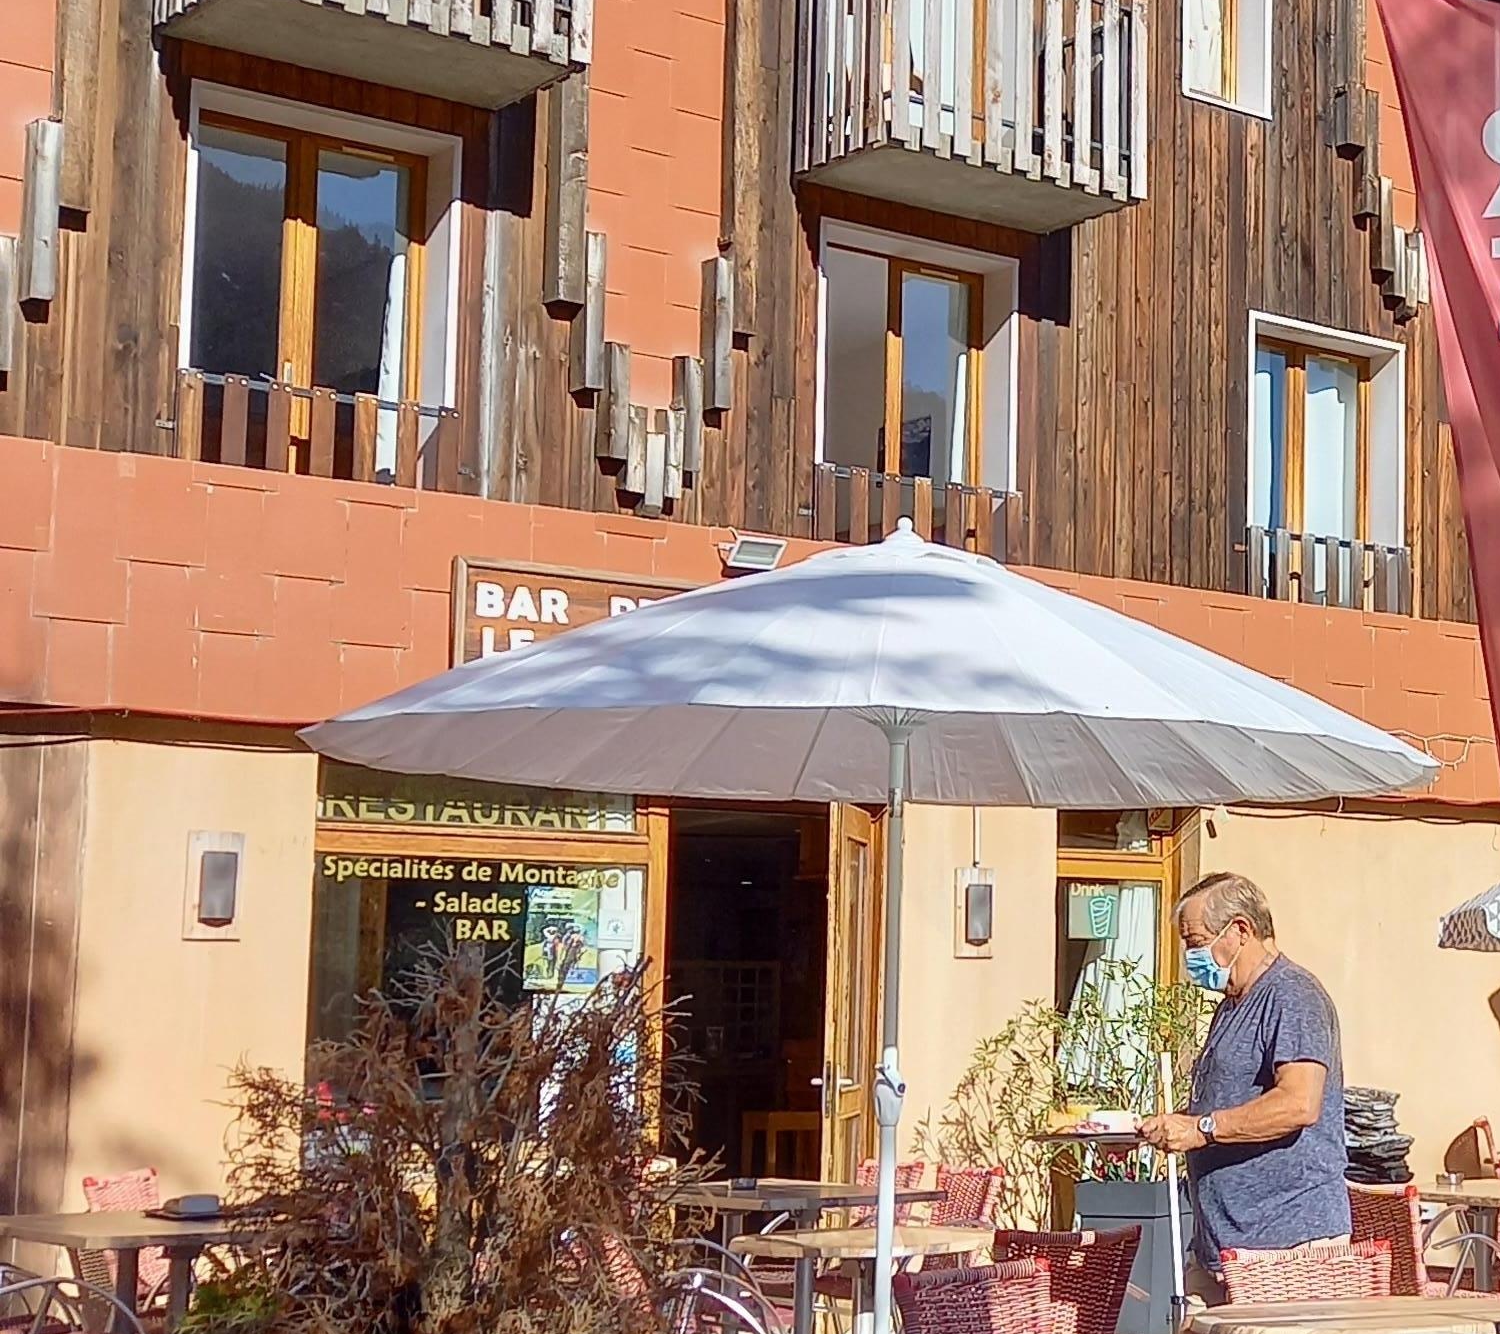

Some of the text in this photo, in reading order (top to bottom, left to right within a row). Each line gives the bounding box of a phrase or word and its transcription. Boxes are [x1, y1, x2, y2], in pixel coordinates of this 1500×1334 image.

[475, 581, 569, 625] BAR
[322, 854, 620, 891] Spécialités de Montagne
[1070, 882, 1105, 897] Drink
[432, 891, 522, 915] Salades
[454, 918, 511, 942] BAR
